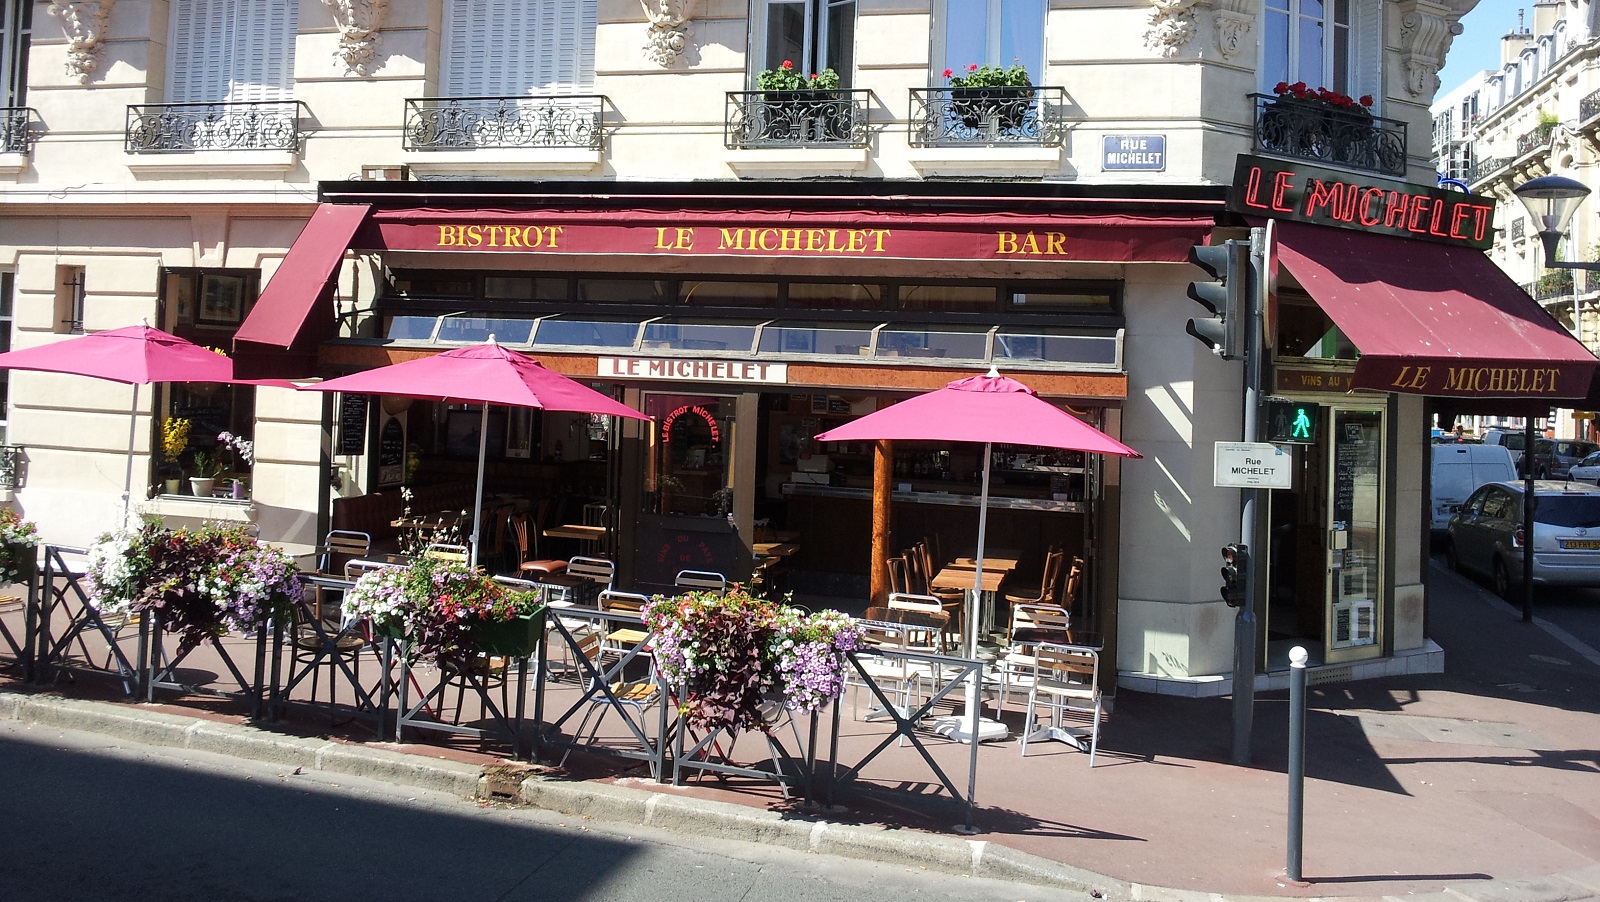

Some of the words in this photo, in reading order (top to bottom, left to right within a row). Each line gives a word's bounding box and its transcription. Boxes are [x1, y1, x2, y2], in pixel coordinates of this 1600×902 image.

[1121, 139, 1148, 150] RUE
[1107, 152, 1162, 165] MICHELET
[1246, 167, 1296, 213] LE
[1306, 178, 1493, 242] MICHELET
[437, 225, 564, 248] BISTROT
[654, 227, 694, 251] LE
[717, 228, 892, 253] MICHELET
[995, 230, 1069, 255] BAR
[613, 358, 640, 376] LE
[649, 360, 771, 381] MICHELET
[1327, 376, 1340, 387] AU
[1391, 366, 1432, 390] LE
[1442, 367, 1561, 393] MICHELET
[662, 432, 670, 443] LE
[1245, 457, 1262, 466] Rue
[1231, 467, 1276, 476] MICHELET
